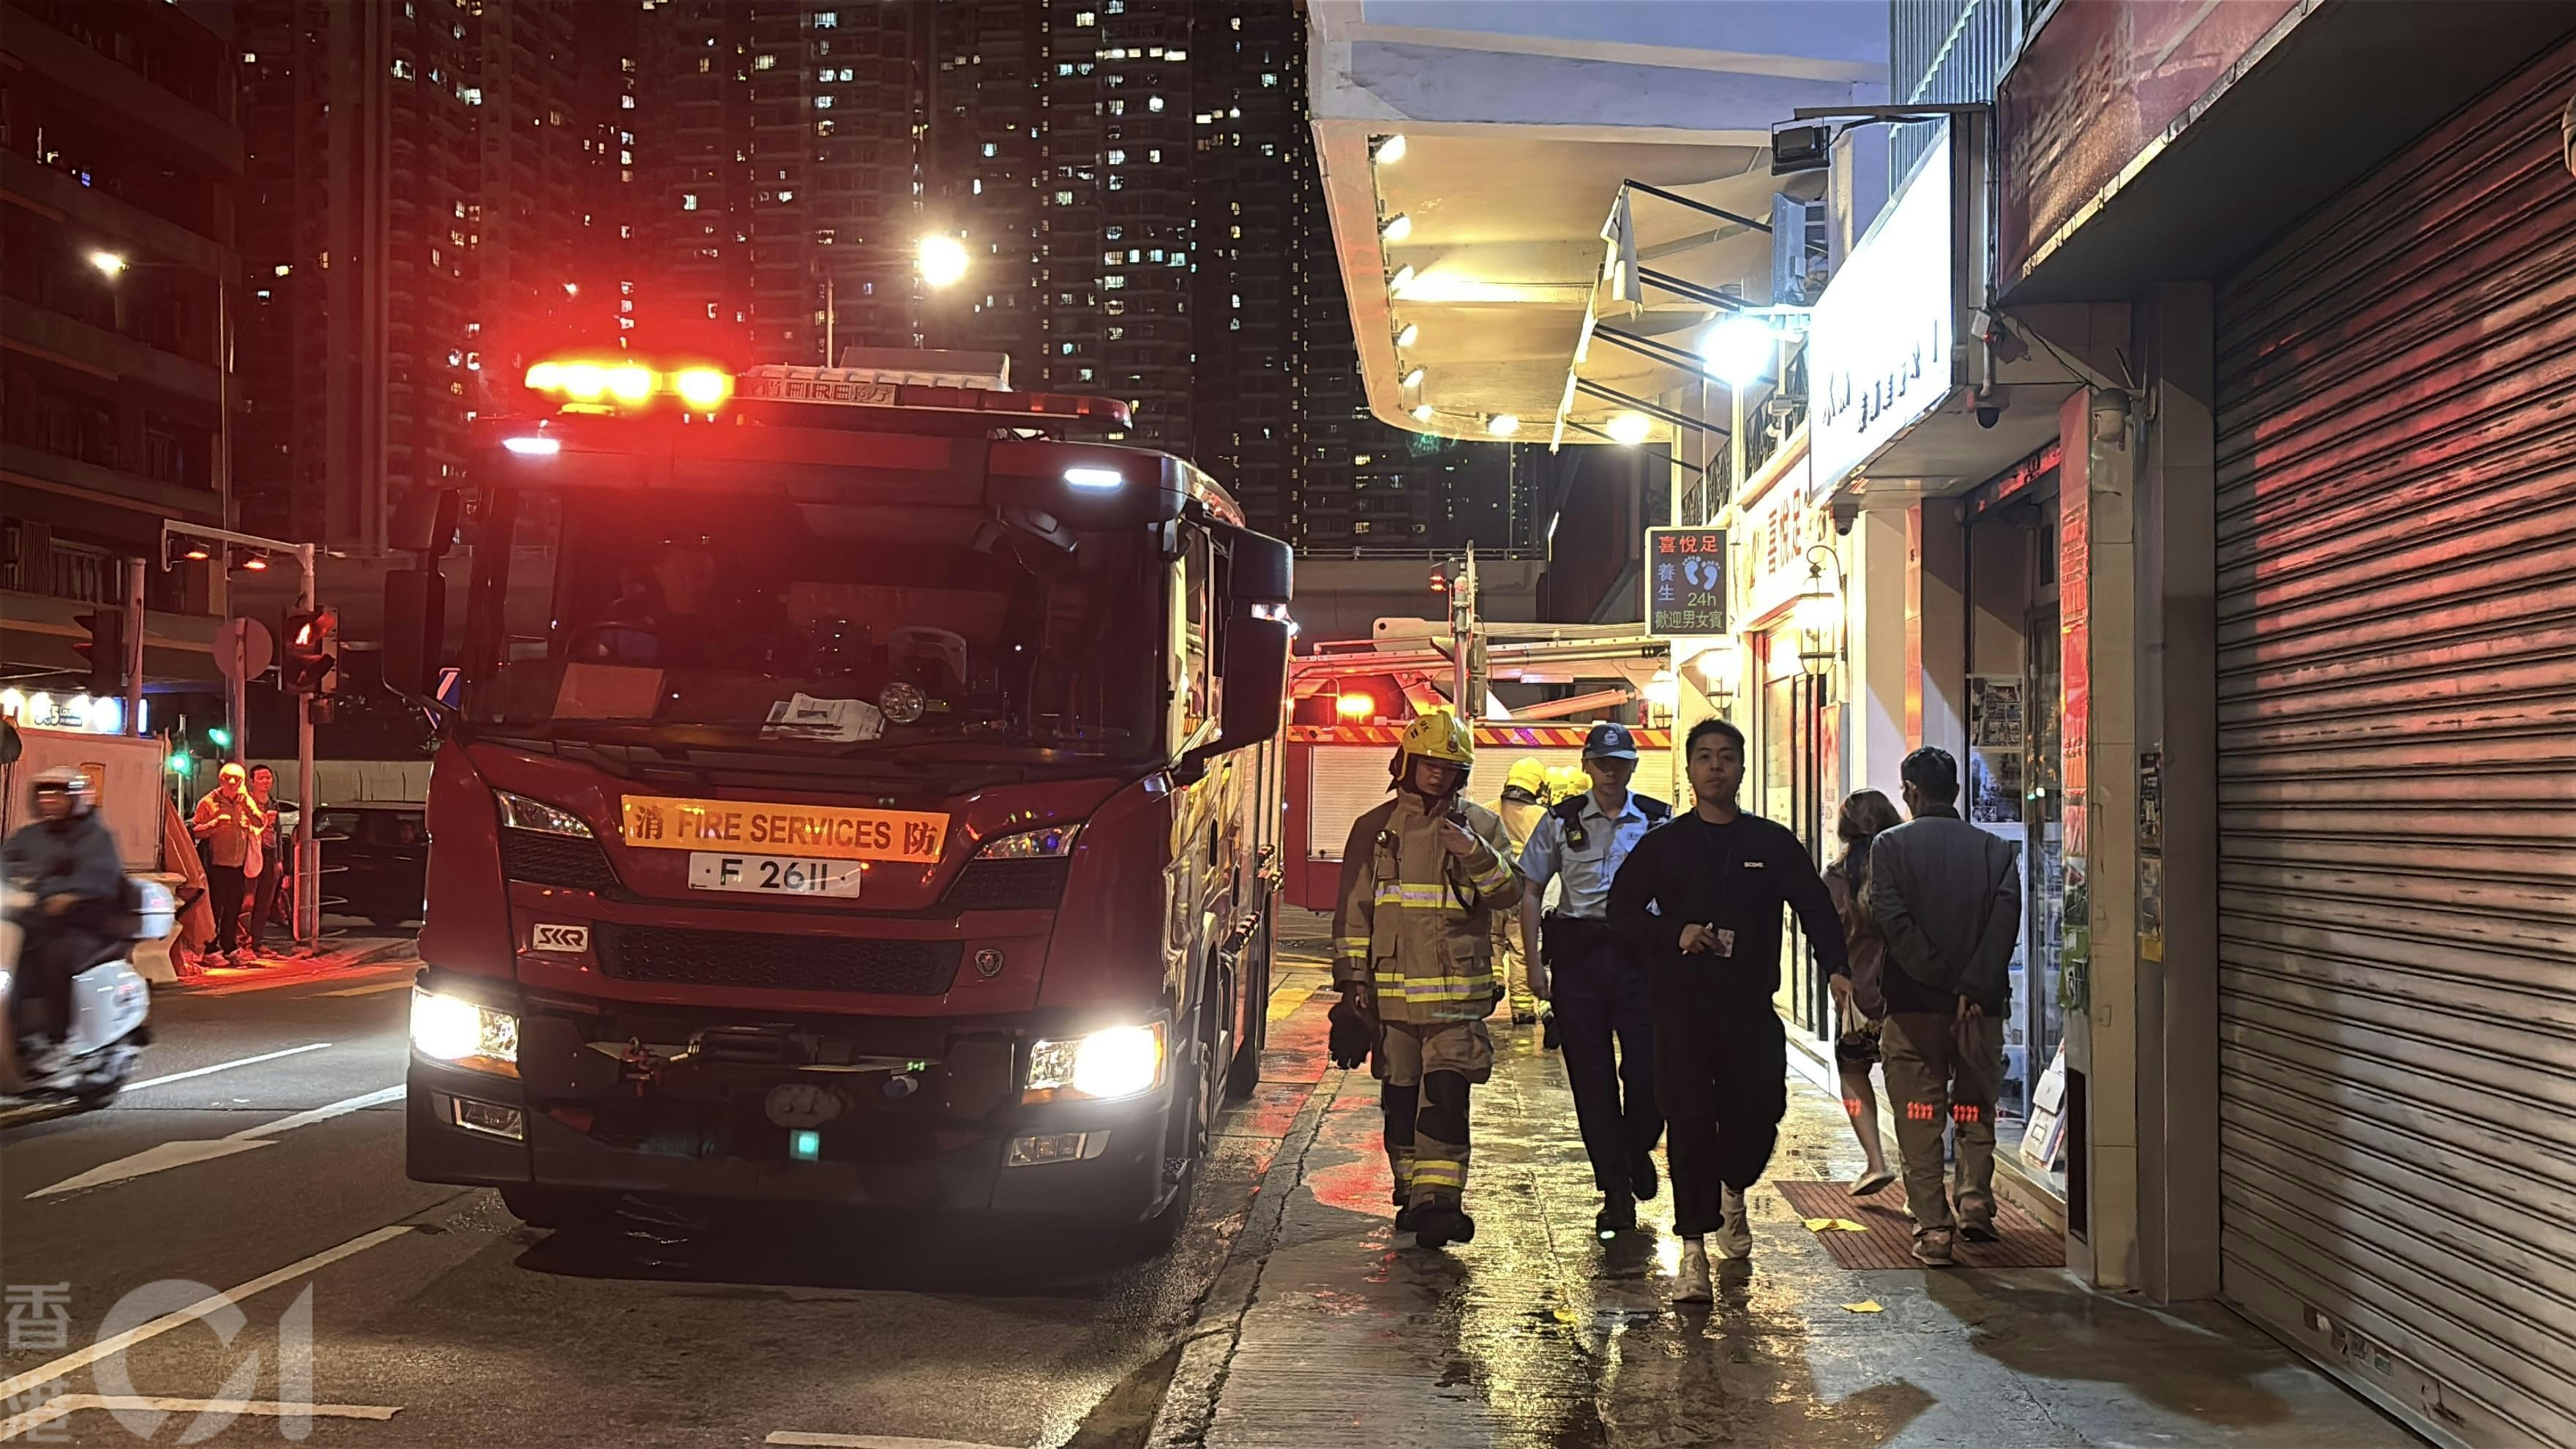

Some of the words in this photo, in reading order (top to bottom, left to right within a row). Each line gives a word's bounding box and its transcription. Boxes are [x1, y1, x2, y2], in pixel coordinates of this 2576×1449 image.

[1658, 536, 1718, 553] 喜悅足
[1658, 563, 1675, 602] 養生
[1688, 592, 1717, 607] 24h
[1655, 610, 1723, 629] 歡迎男女賓
[635, 805, 664, 840] 消
[678, 809, 743, 842] FIRE
[750, 814, 892, 850] SERVICES
[903, 820, 939, 856] 防
[720, 858, 744, 887] F
[760, 861, 828, 891] 2611
